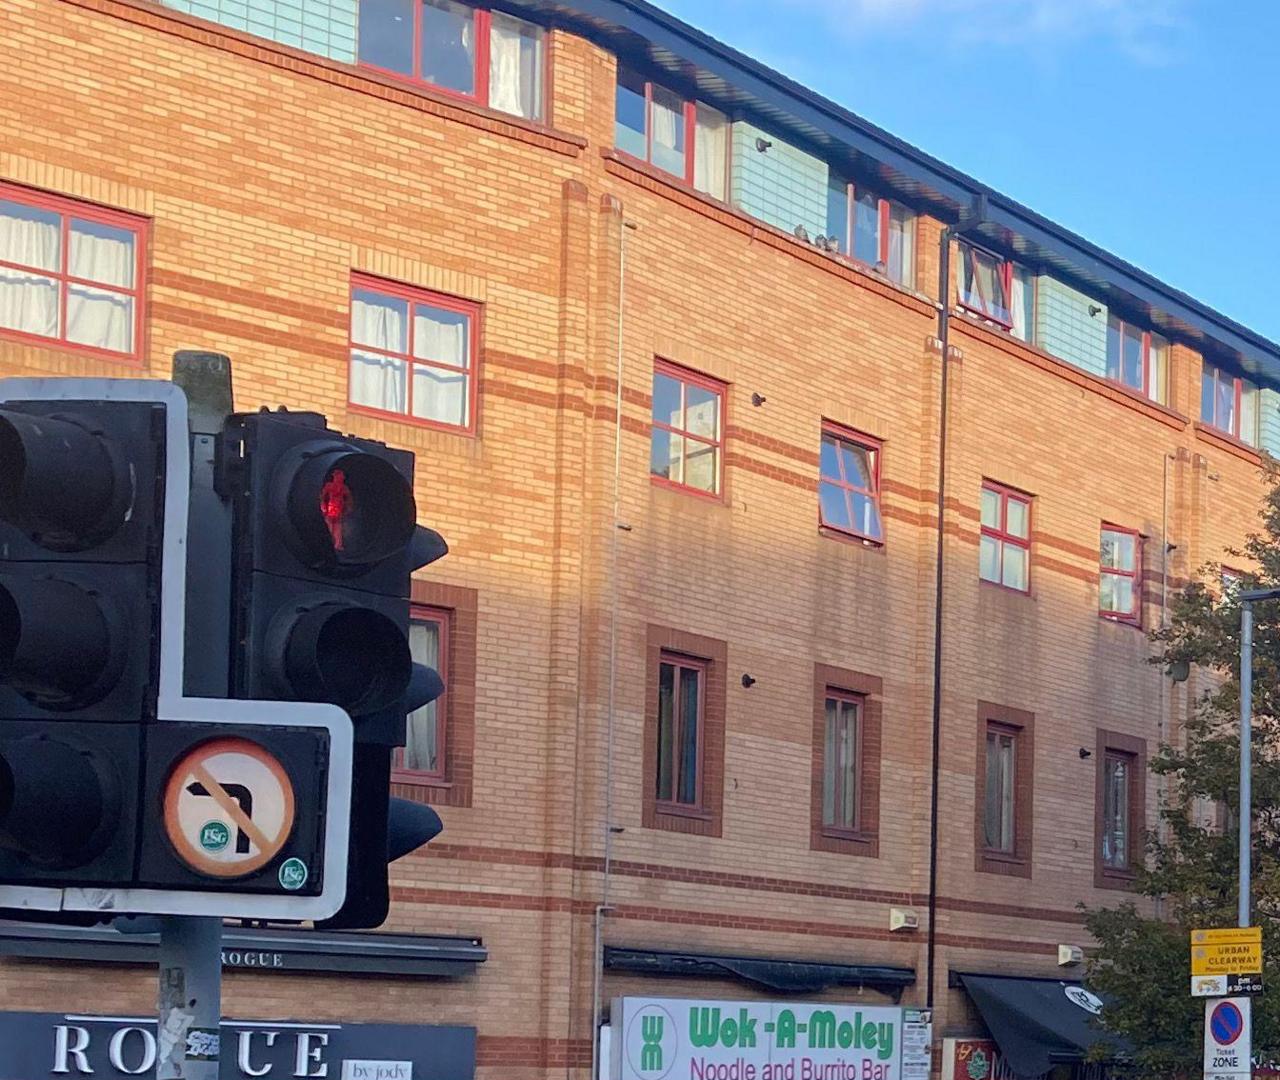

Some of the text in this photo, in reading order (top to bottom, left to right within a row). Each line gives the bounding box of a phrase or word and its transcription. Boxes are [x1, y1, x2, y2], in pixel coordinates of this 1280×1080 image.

[1217, 946, 1250, 955] URBAN
[220, 952, 283, 967] ROGUE
[1208, 956, 1258, 965] CLEARWAY
[1237, 977, 1251, 986] pm
[689, 1006, 757, 1049] Wok
[51, 1025, 328, 1078] ROUE
[1216, 1048, 1236, 1056] Ticket
[1212, 1056, 1239, 1068] ZONE
[352, 1063, 371, 1079] by
[861, 1059, 890, 1080] Bar
